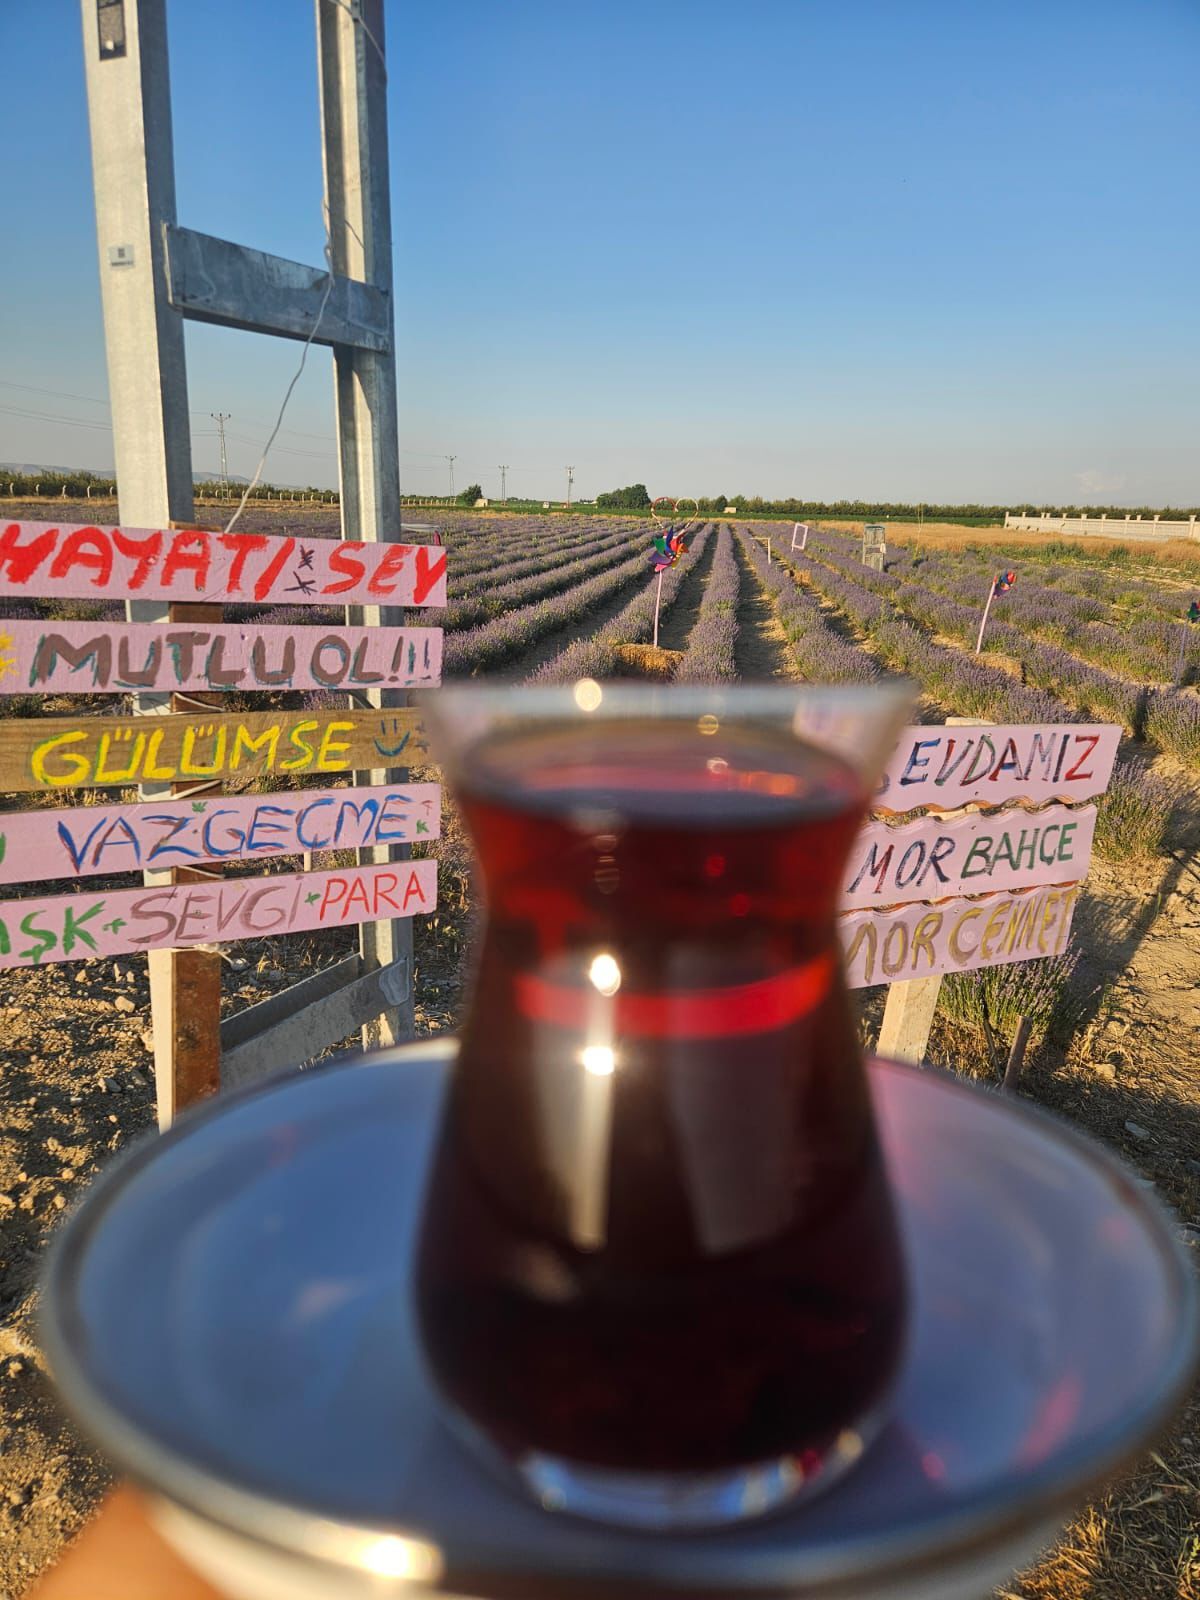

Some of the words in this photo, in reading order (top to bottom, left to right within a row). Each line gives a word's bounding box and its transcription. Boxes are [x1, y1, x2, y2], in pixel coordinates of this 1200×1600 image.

[320, 540, 447, 604] SEV
[28, 631, 296, 691] MUTLU
[30, 720, 359, 786] GÜLÜMSE
[876, 732, 1100, 796] EVDAMIZ
[319, 870, 426, 921] PARA
[845, 836, 956, 895] MOR
